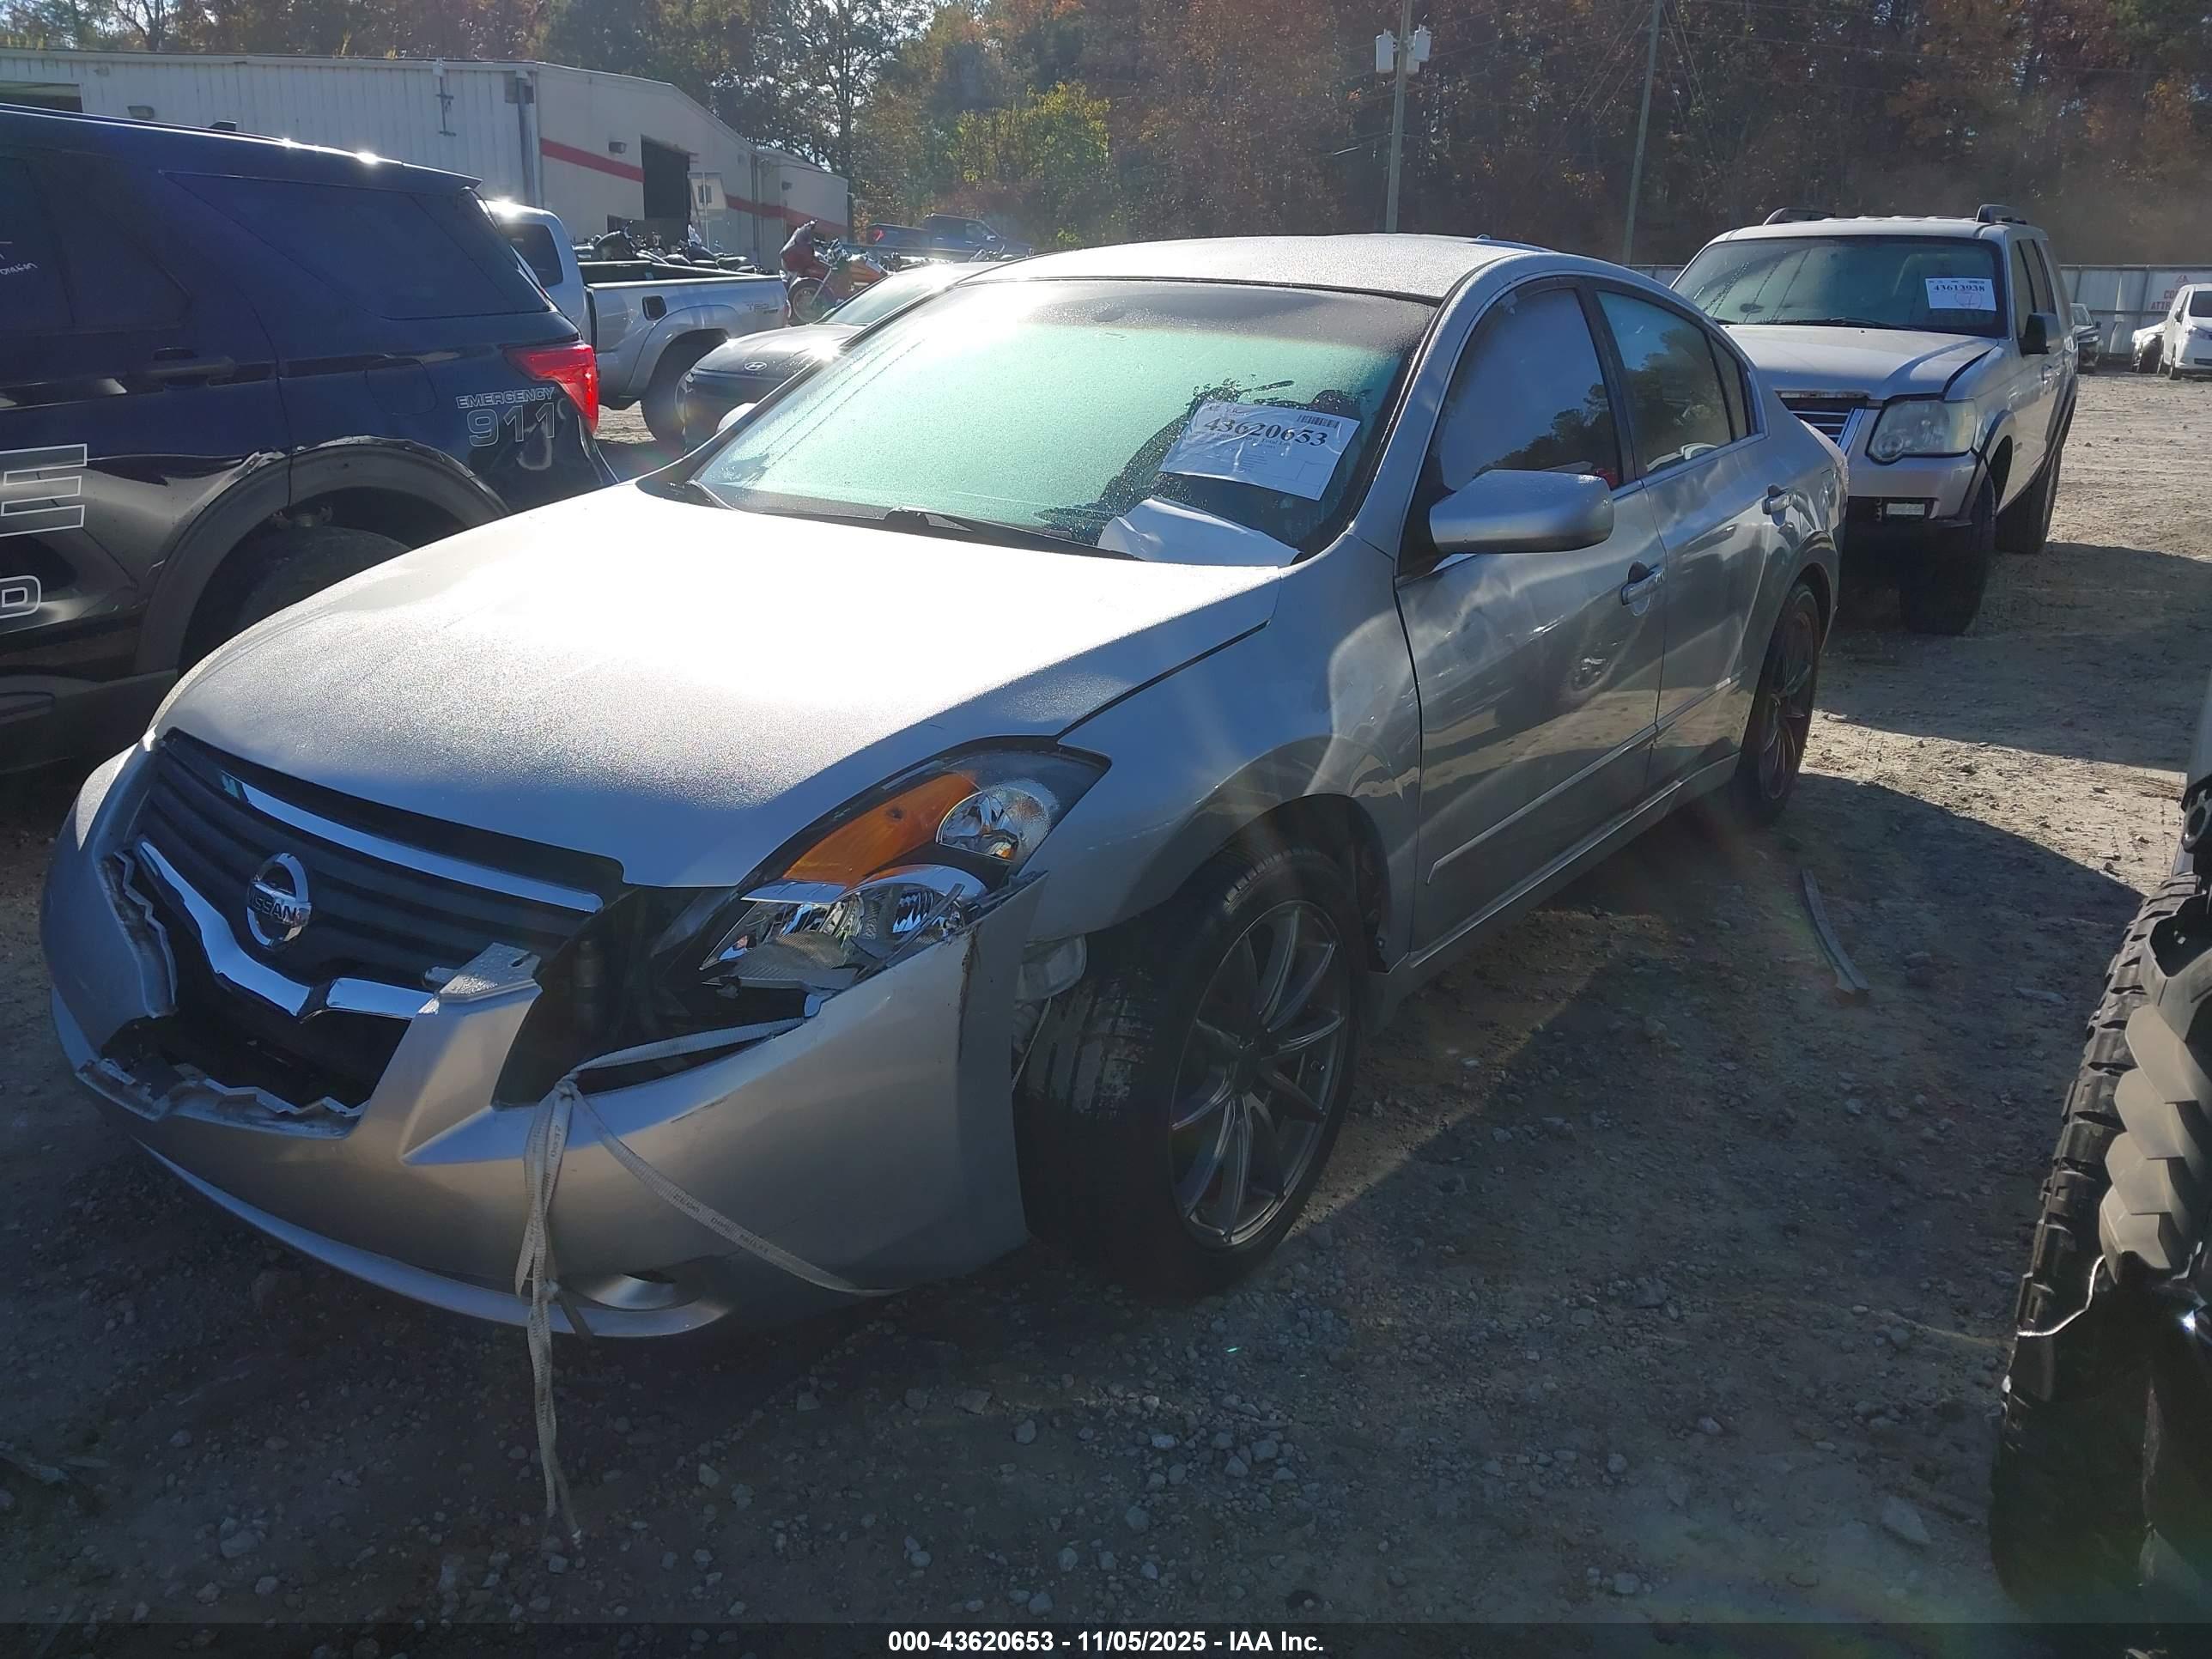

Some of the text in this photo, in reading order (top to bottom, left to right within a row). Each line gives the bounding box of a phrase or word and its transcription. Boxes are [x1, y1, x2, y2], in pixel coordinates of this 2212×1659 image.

[456, 387, 555, 409] EMERGENCY
[467, 403, 555, 447] 911
[1204, 418, 1328, 447] 43620653
